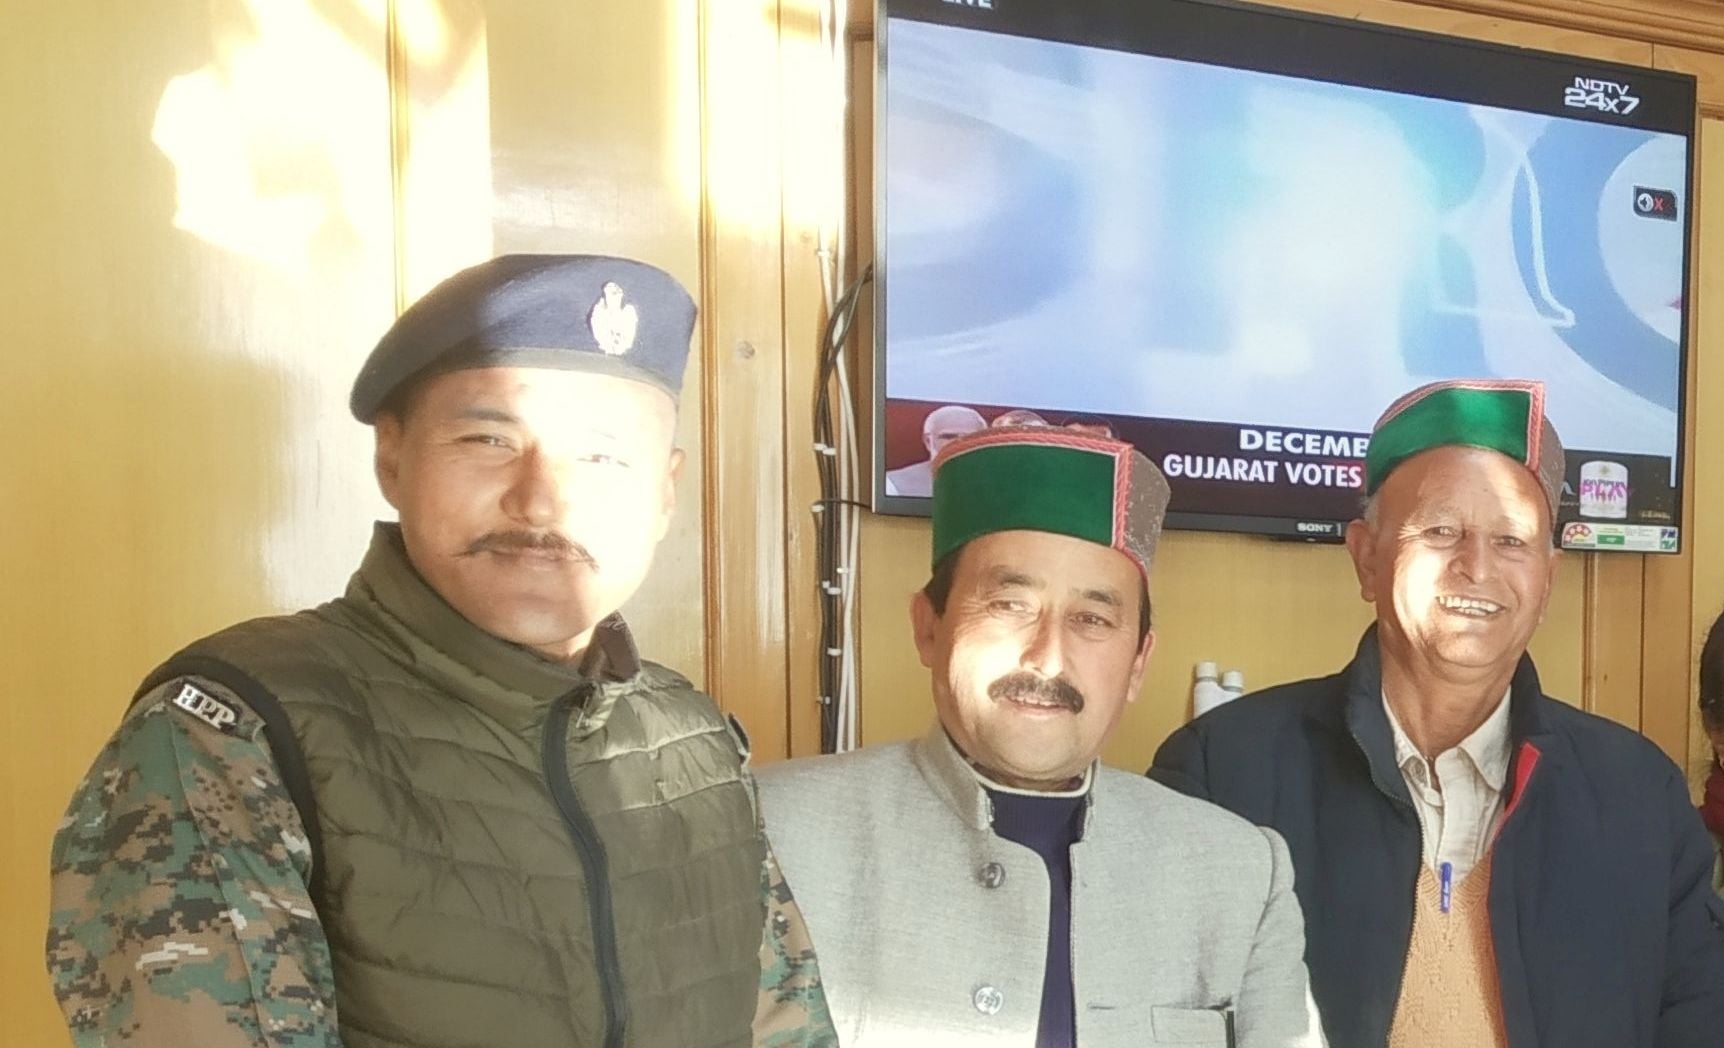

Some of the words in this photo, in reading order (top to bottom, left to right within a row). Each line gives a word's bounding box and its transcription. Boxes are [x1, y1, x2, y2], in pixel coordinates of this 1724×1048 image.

[1574, 76, 1630, 95] NDTV
[1239, 428, 1370, 458] DECEMB
[1163, 453, 1278, 483] GUJARAT
[1285, 461, 1363, 488] VOTES
[1297, 523, 1333, 533] SONY
